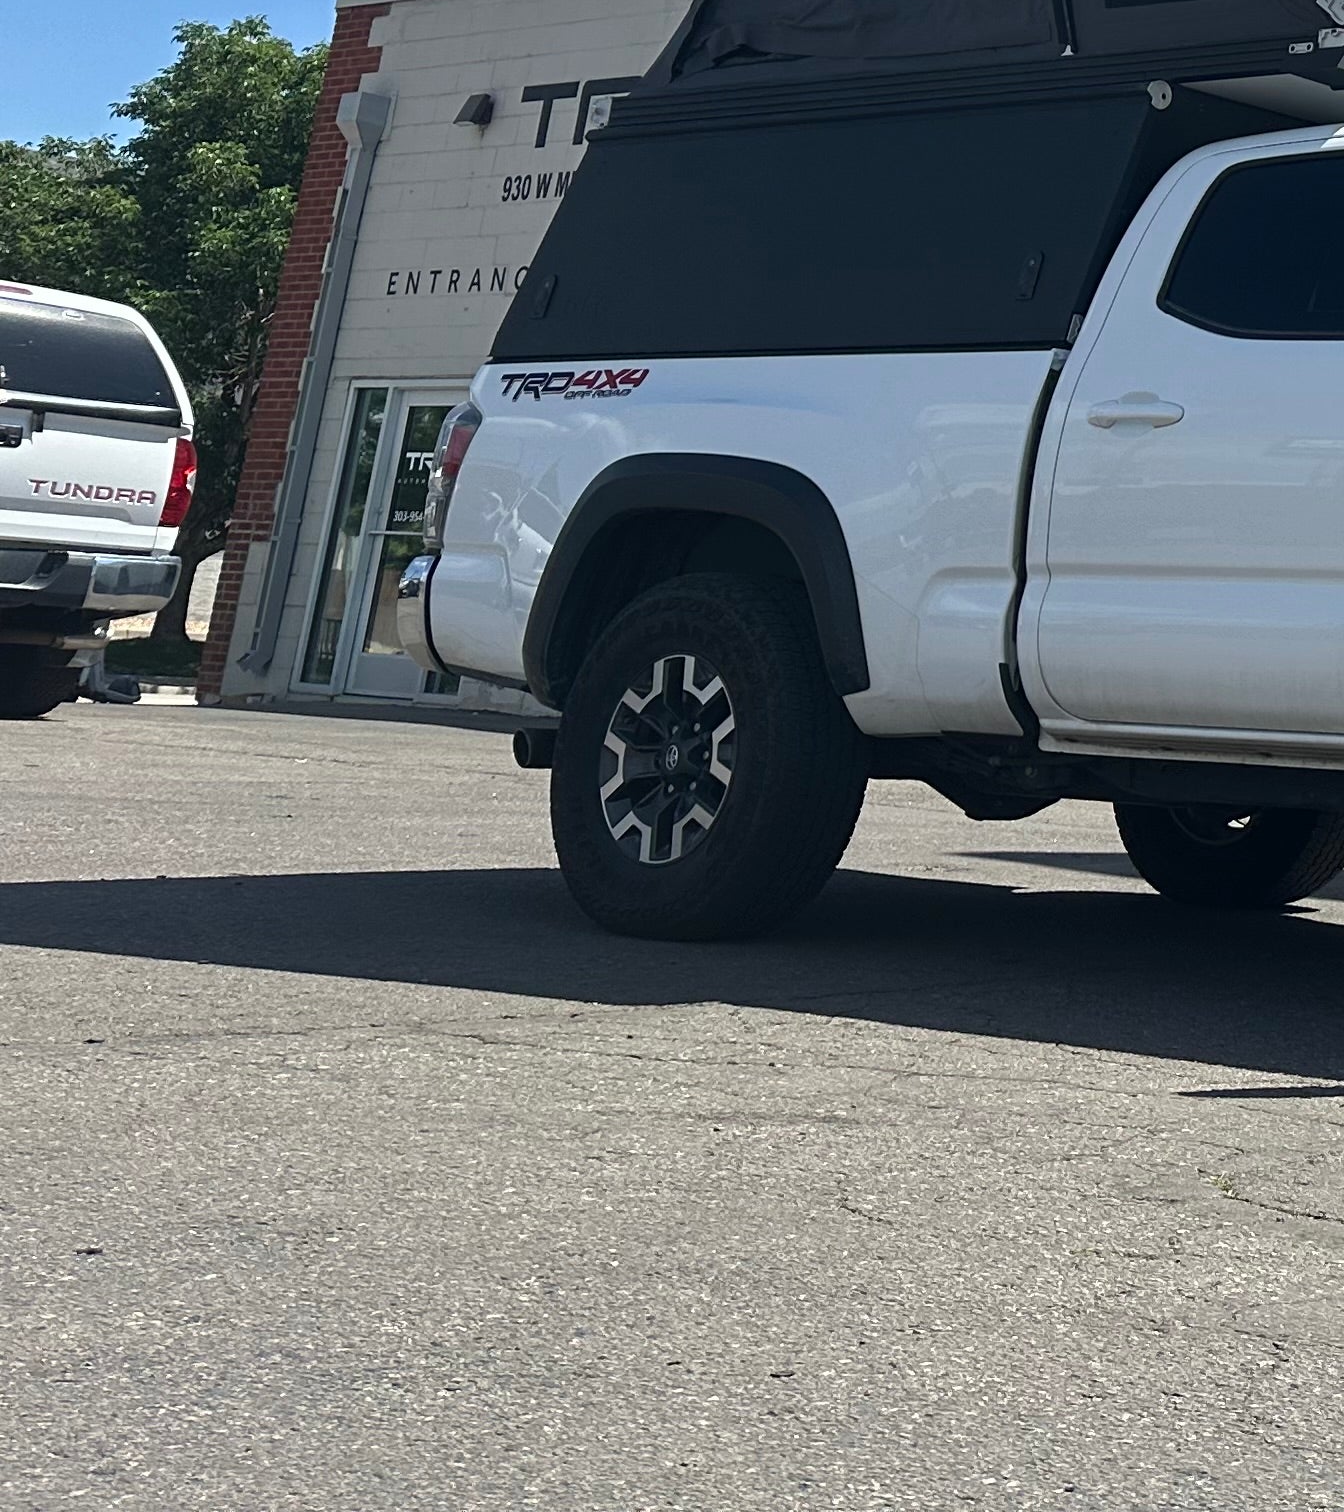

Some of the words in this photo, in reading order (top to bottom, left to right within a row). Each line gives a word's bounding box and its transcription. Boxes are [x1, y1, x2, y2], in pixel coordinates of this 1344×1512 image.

[501, 173, 532, 203] 930
[535, 172, 553, 199] W
[501, 371, 575, 402] TRD
[27, 478, 158, 506] TUNDRA
